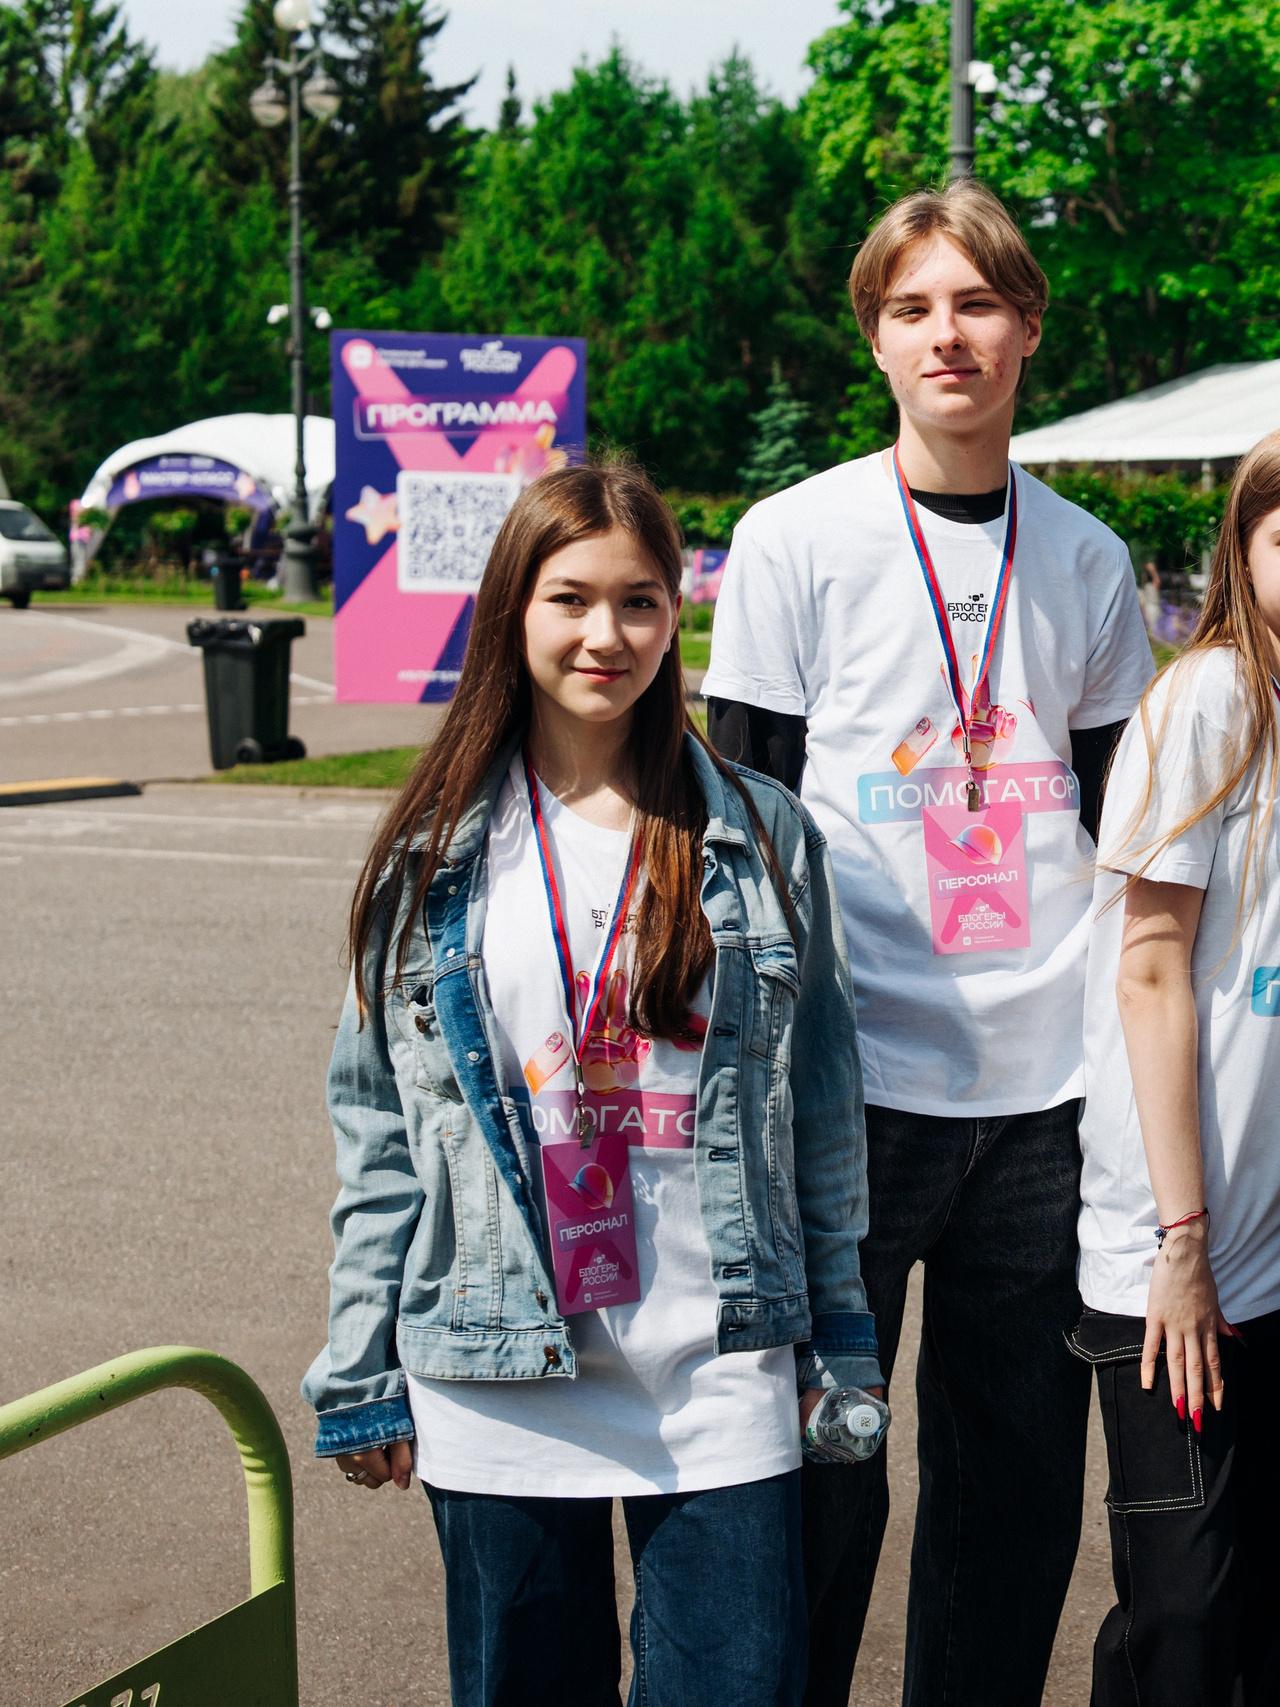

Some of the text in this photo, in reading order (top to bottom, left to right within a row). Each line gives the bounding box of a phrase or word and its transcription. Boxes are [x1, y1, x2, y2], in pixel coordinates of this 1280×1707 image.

[366, 400, 558, 429] ПРОГРАММА
[938, 870, 1018, 891] ПЕРСОНАЛ
[958, 911, 1006, 924] БЛОГЕРЫ
[961, 920, 1004, 931] РОССИИ
[560, 1214, 628, 1242] ПЕРСОНАЛ
[579, 1261, 619, 1278] БЛОГЕРЫ
[582, 1272, 618, 1287] РОССИИ
